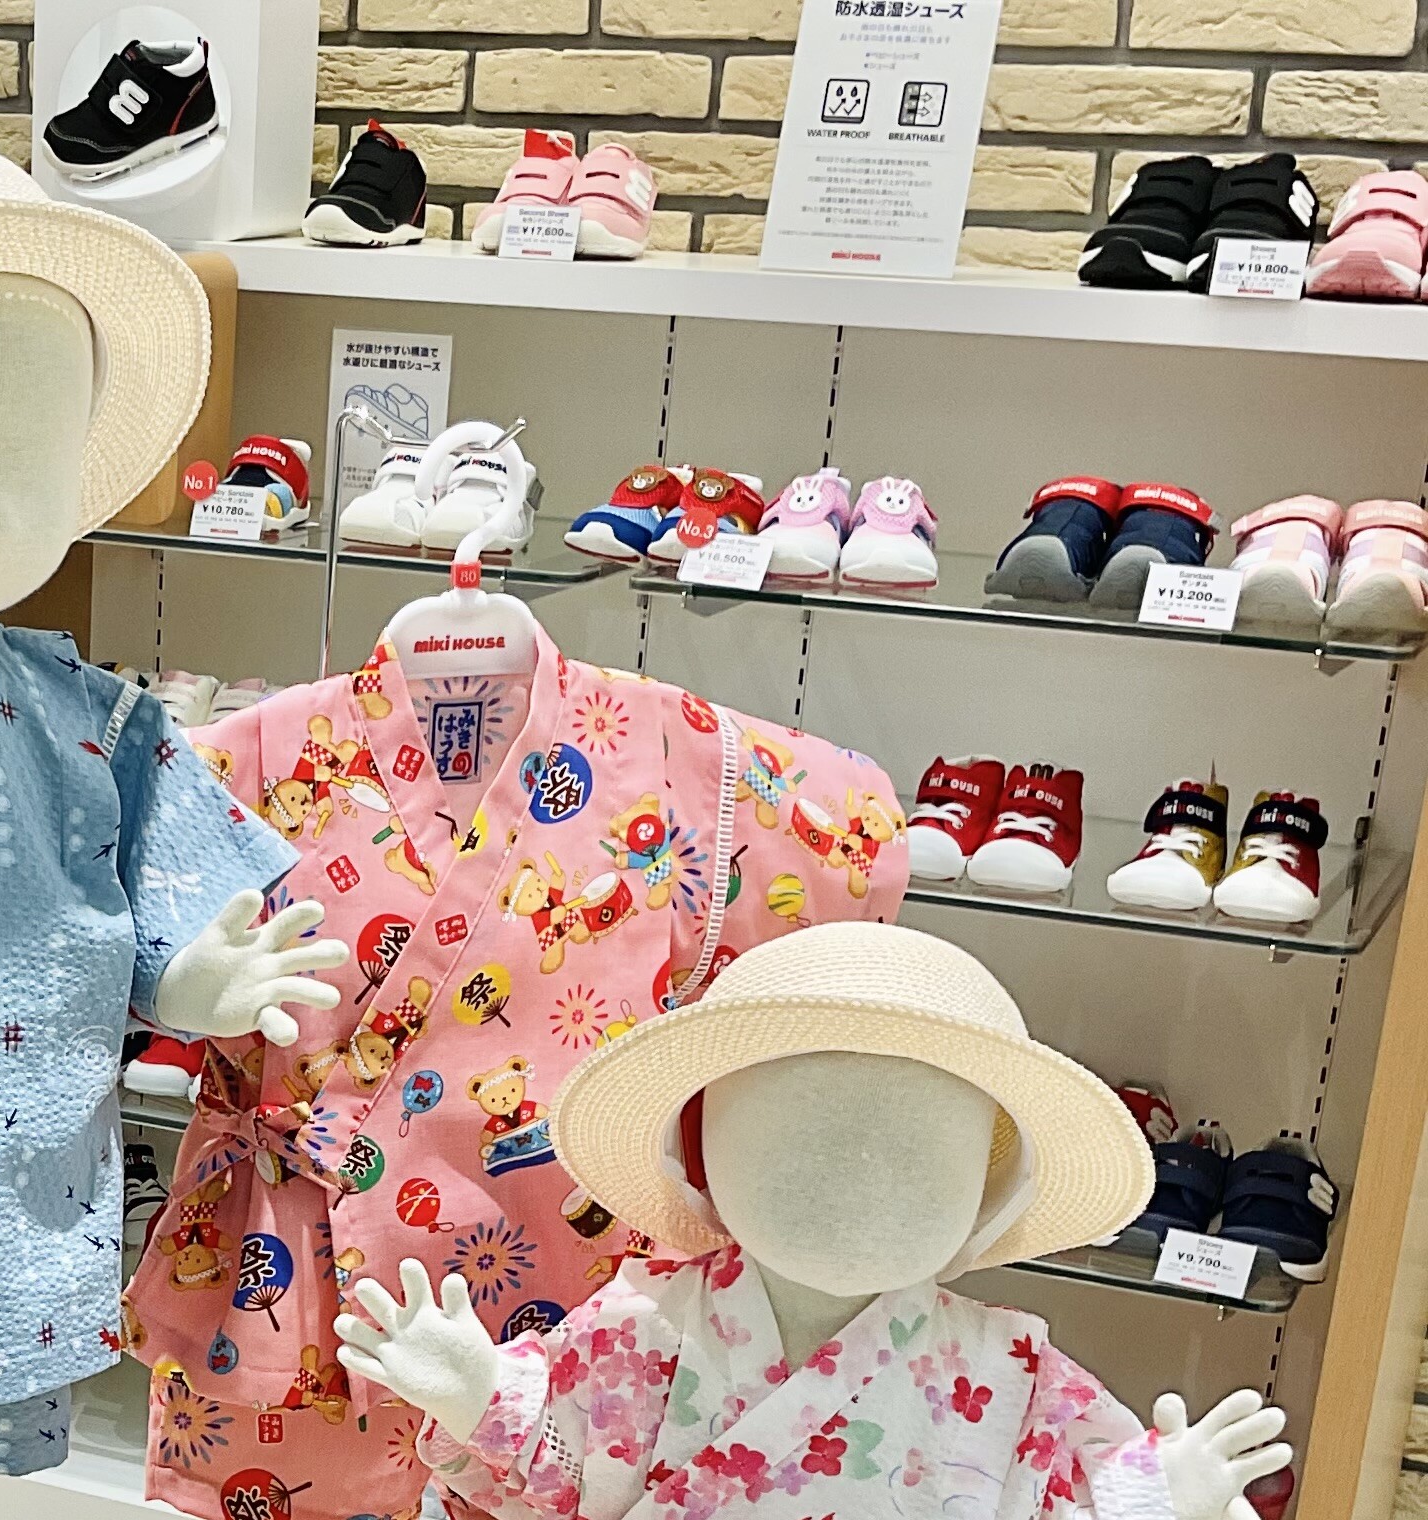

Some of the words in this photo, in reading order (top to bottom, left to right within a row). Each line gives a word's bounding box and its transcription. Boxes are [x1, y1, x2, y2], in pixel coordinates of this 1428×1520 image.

[807, 128, 838, 138] WATER
[840, 129, 871, 139] PROOF
[888, 132, 946, 143] BREATHABLE
[342, 357, 441, 371] 水遊びに最適なシューズ
[184, 475, 214, 490] No.1
[678, 519, 715, 540] No.3
[460, 569, 477, 583] 80
[1158, 588, 1213, 602] ¥13,200
[452, 636, 506, 651] HOUSE
